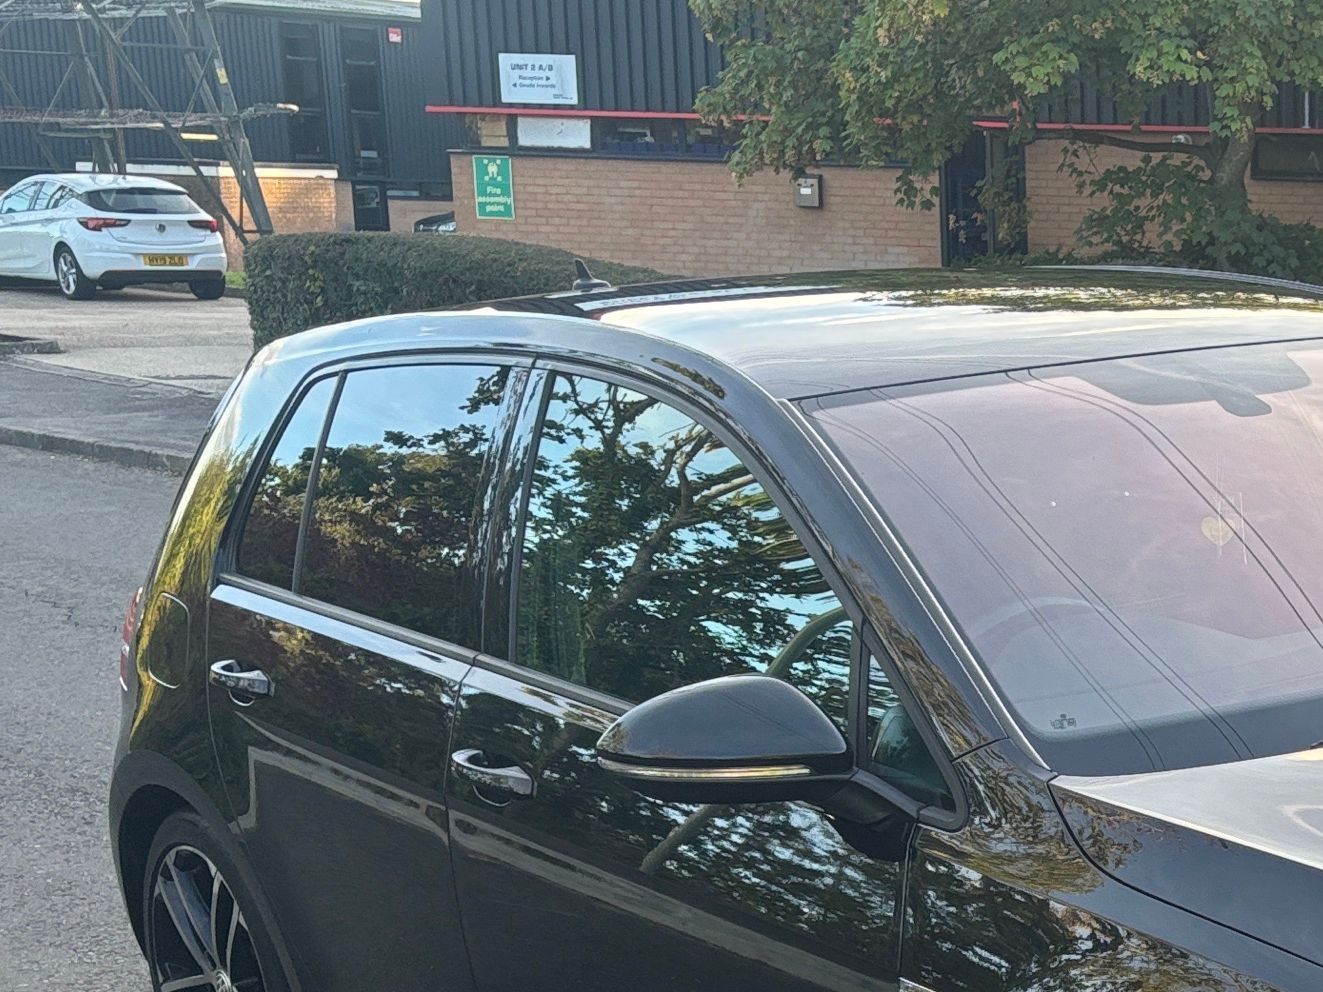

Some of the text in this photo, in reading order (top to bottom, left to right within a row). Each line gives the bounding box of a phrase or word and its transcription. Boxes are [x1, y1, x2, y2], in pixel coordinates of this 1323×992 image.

[510, 63, 529, 71] UNIT
[486, 186, 502, 195] Fire
[486, 204, 505, 213] point
